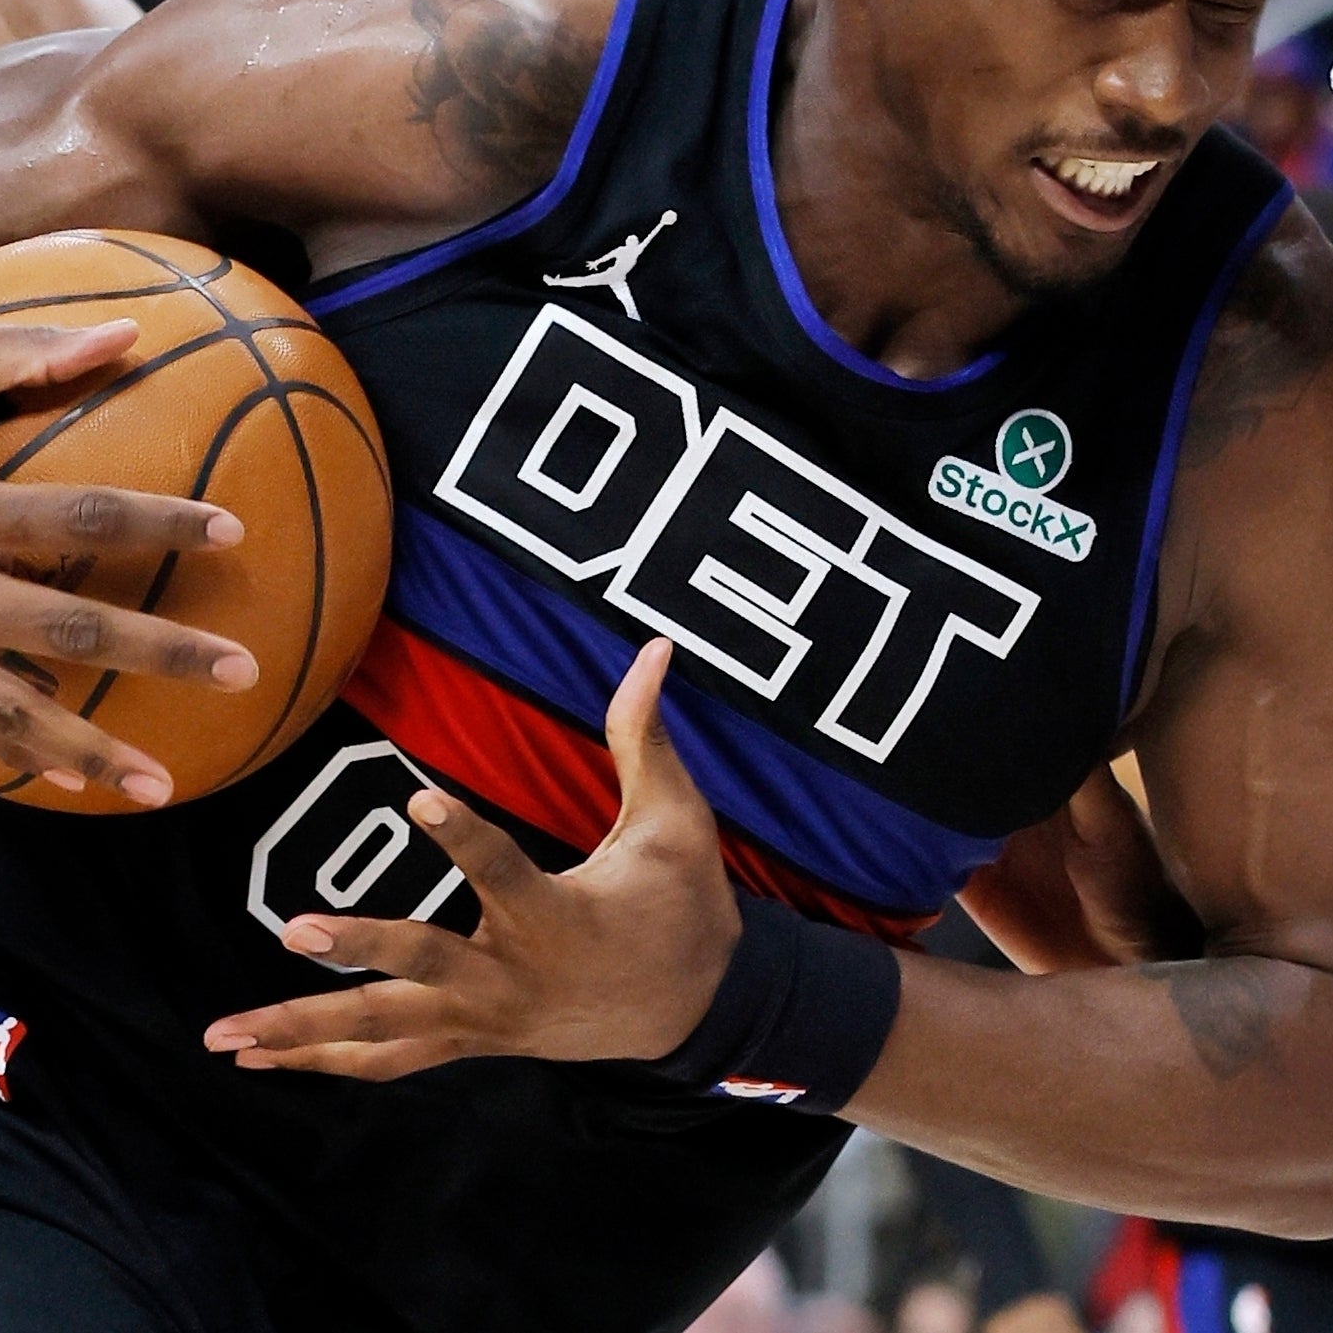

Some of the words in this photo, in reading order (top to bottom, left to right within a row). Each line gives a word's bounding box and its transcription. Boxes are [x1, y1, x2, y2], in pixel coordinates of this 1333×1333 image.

[432, 302, 1041, 764] DET
[935, 463, 1090, 555] StockX
[247, 739, 467, 974] 0
